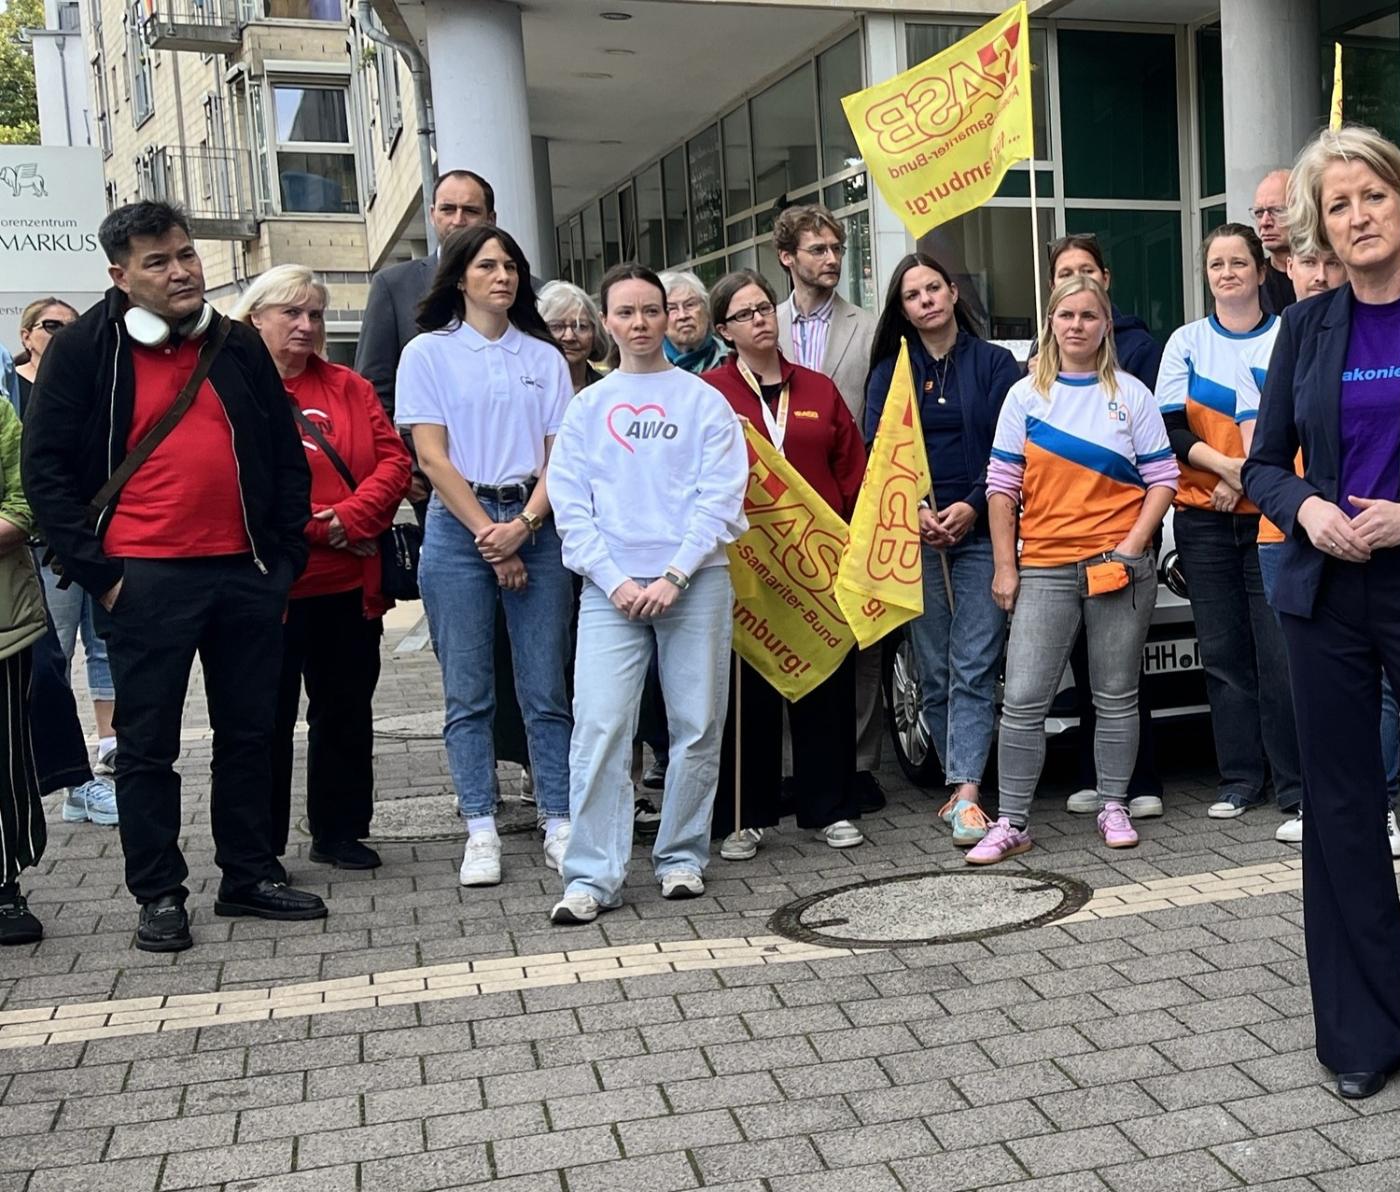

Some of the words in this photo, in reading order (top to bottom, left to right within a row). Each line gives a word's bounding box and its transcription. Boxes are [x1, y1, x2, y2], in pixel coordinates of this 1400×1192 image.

[0, 218, 78, 228] orenzentrum
[0, 233, 97, 252] MARKUS
[626, 420, 679, 440] AWO
[736, 539, 843, 649] -Samariter-Bund
[733, 598, 812, 679] mburg!
